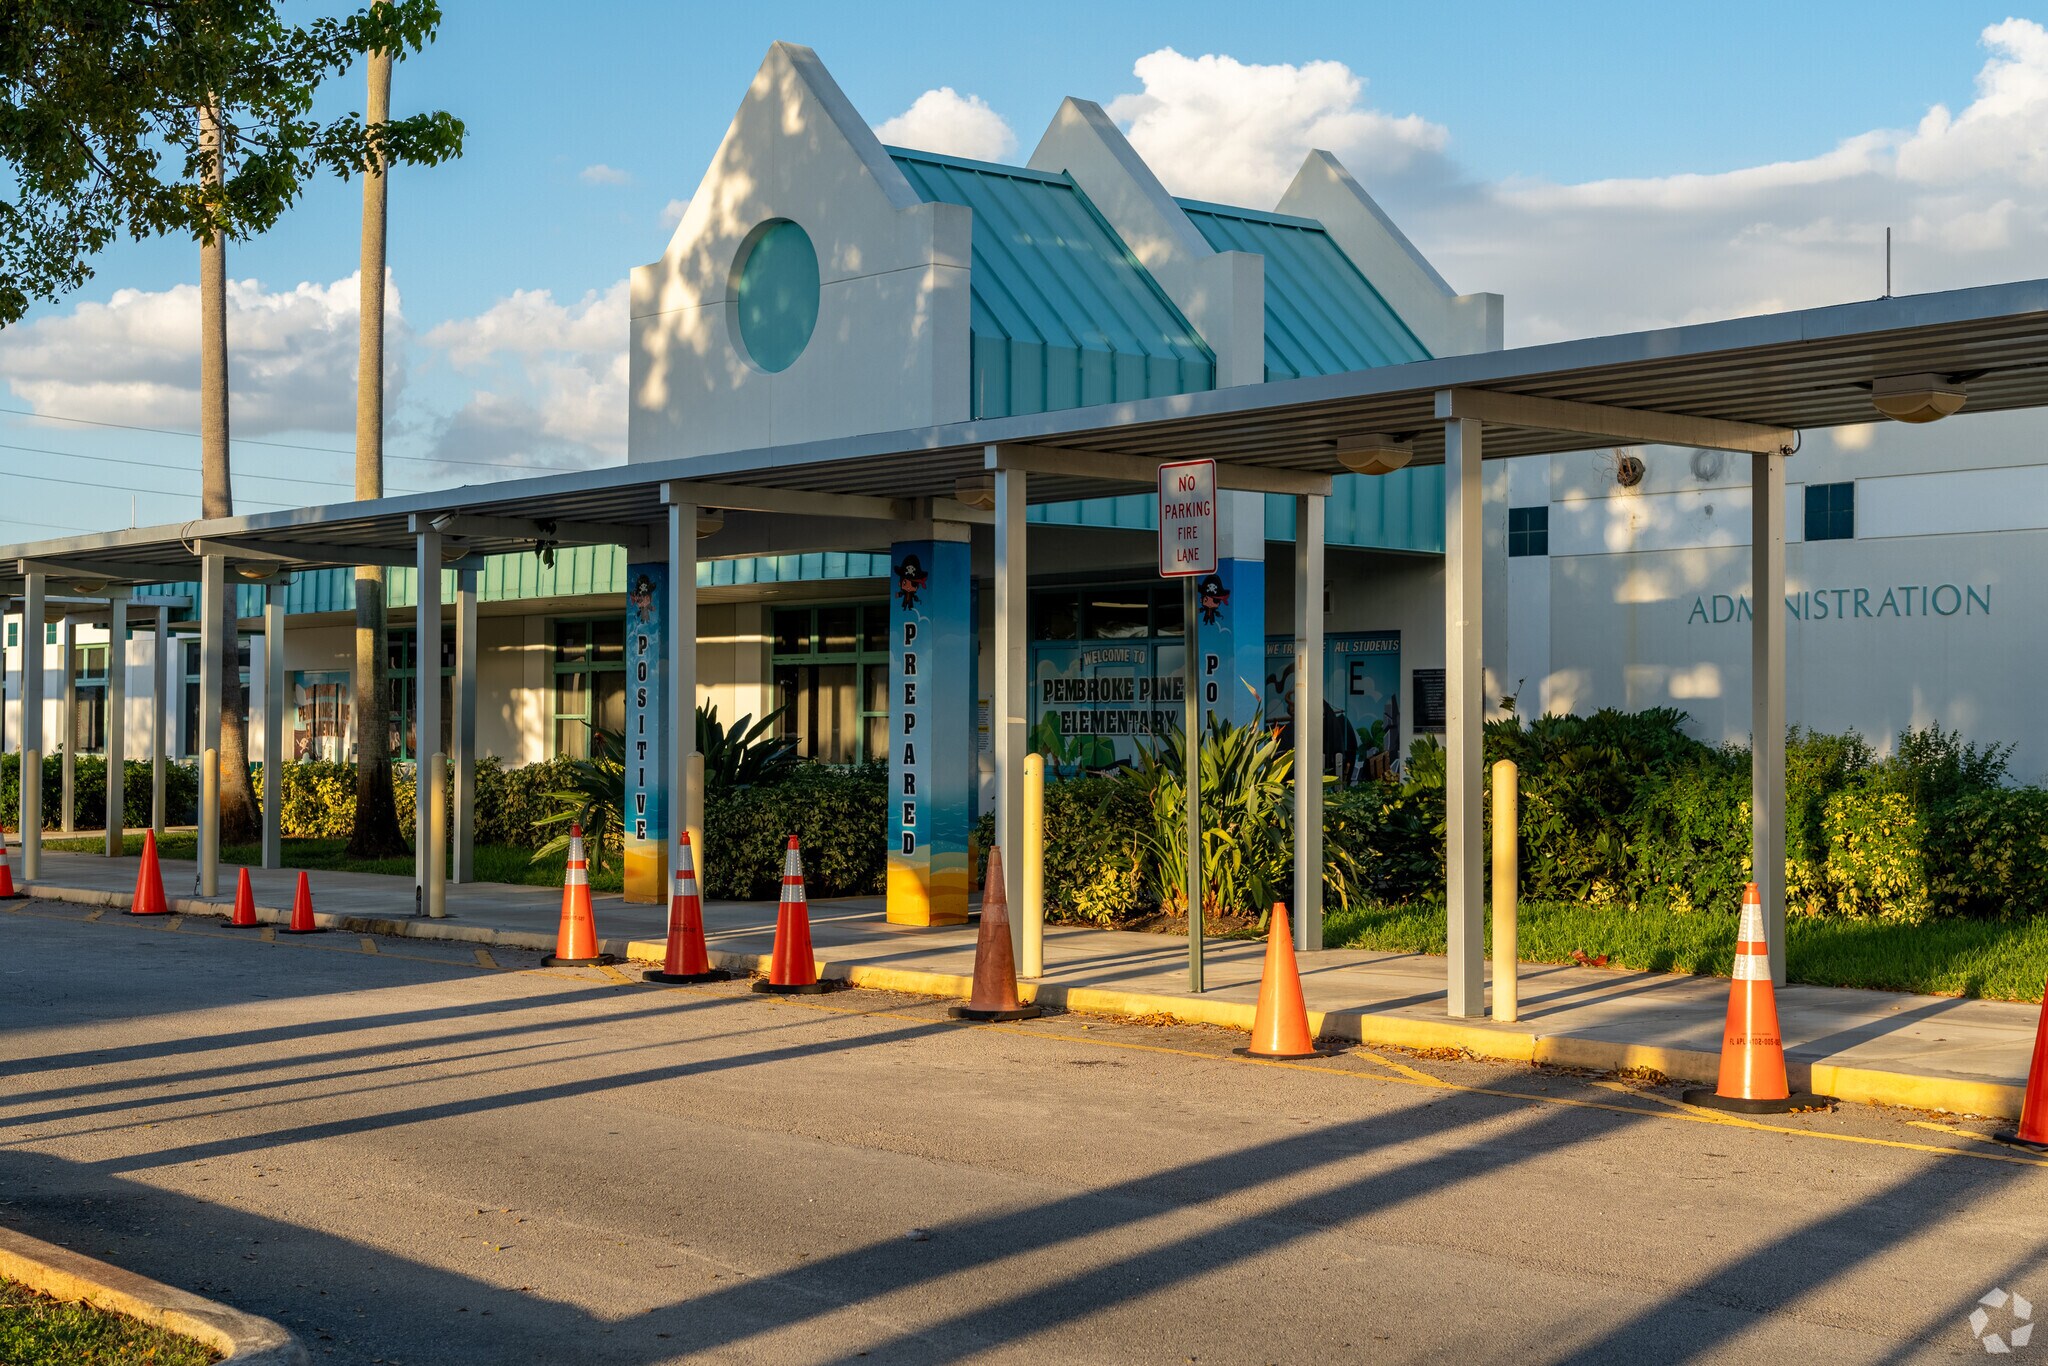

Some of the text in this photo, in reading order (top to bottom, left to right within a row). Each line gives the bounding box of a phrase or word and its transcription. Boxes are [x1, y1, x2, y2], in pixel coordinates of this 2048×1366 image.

[1179, 475, 1195, 492] NO
[1165, 500, 1210, 519] PARKING
[1178, 525, 1198, 540] FIRE
[1177, 547, 1200, 562] LANE
[1687, 583, 1991, 625] ADNISTRATION
[1267, 643, 1279, 655] WE
[1334, 641, 1349, 653] ALL
[1352, 639, 1400, 652] STUDENTS
[1084, 649, 1146, 665] WELCOME TO
[1043, 676, 1185, 703] PEMBROKE PINE
[1060, 710, 1178, 735] ELEMENTARY
[636, 635, 648, 840] POSITIVE
[902, 623, 917, 855] PREPARED
